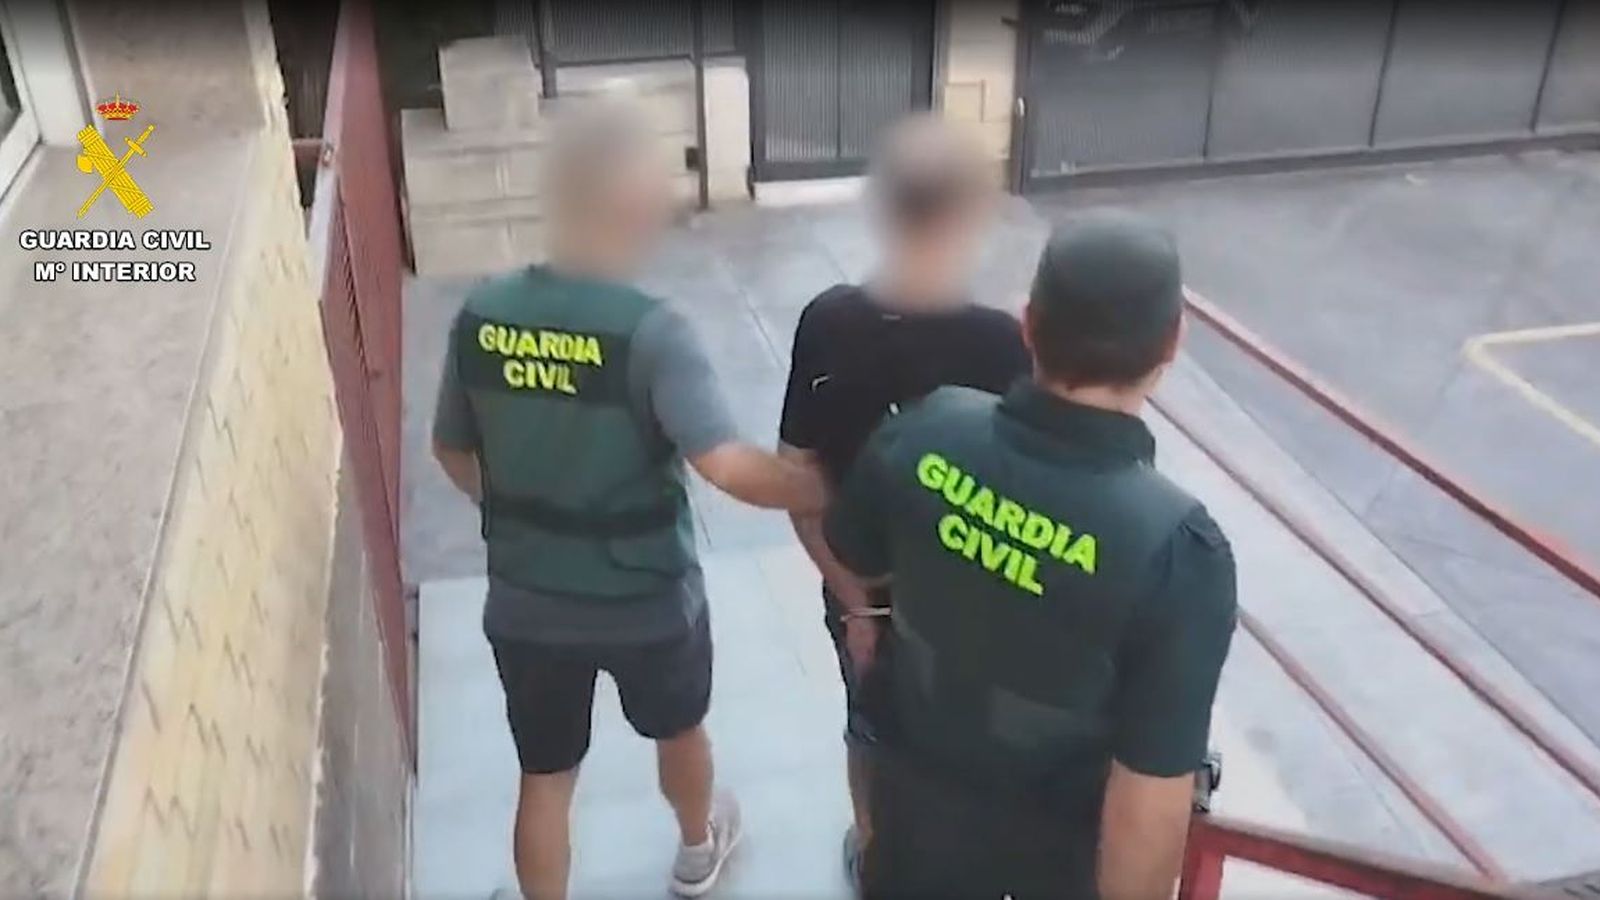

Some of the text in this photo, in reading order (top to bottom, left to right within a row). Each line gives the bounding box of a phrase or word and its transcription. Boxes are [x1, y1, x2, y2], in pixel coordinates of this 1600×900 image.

[478, 323, 603, 366] GUARDIA
[503, 360, 577, 394] CIVIL
[917, 453, 1097, 575] GUARDIA
[937, 513, 1044, 597] CIVIL
